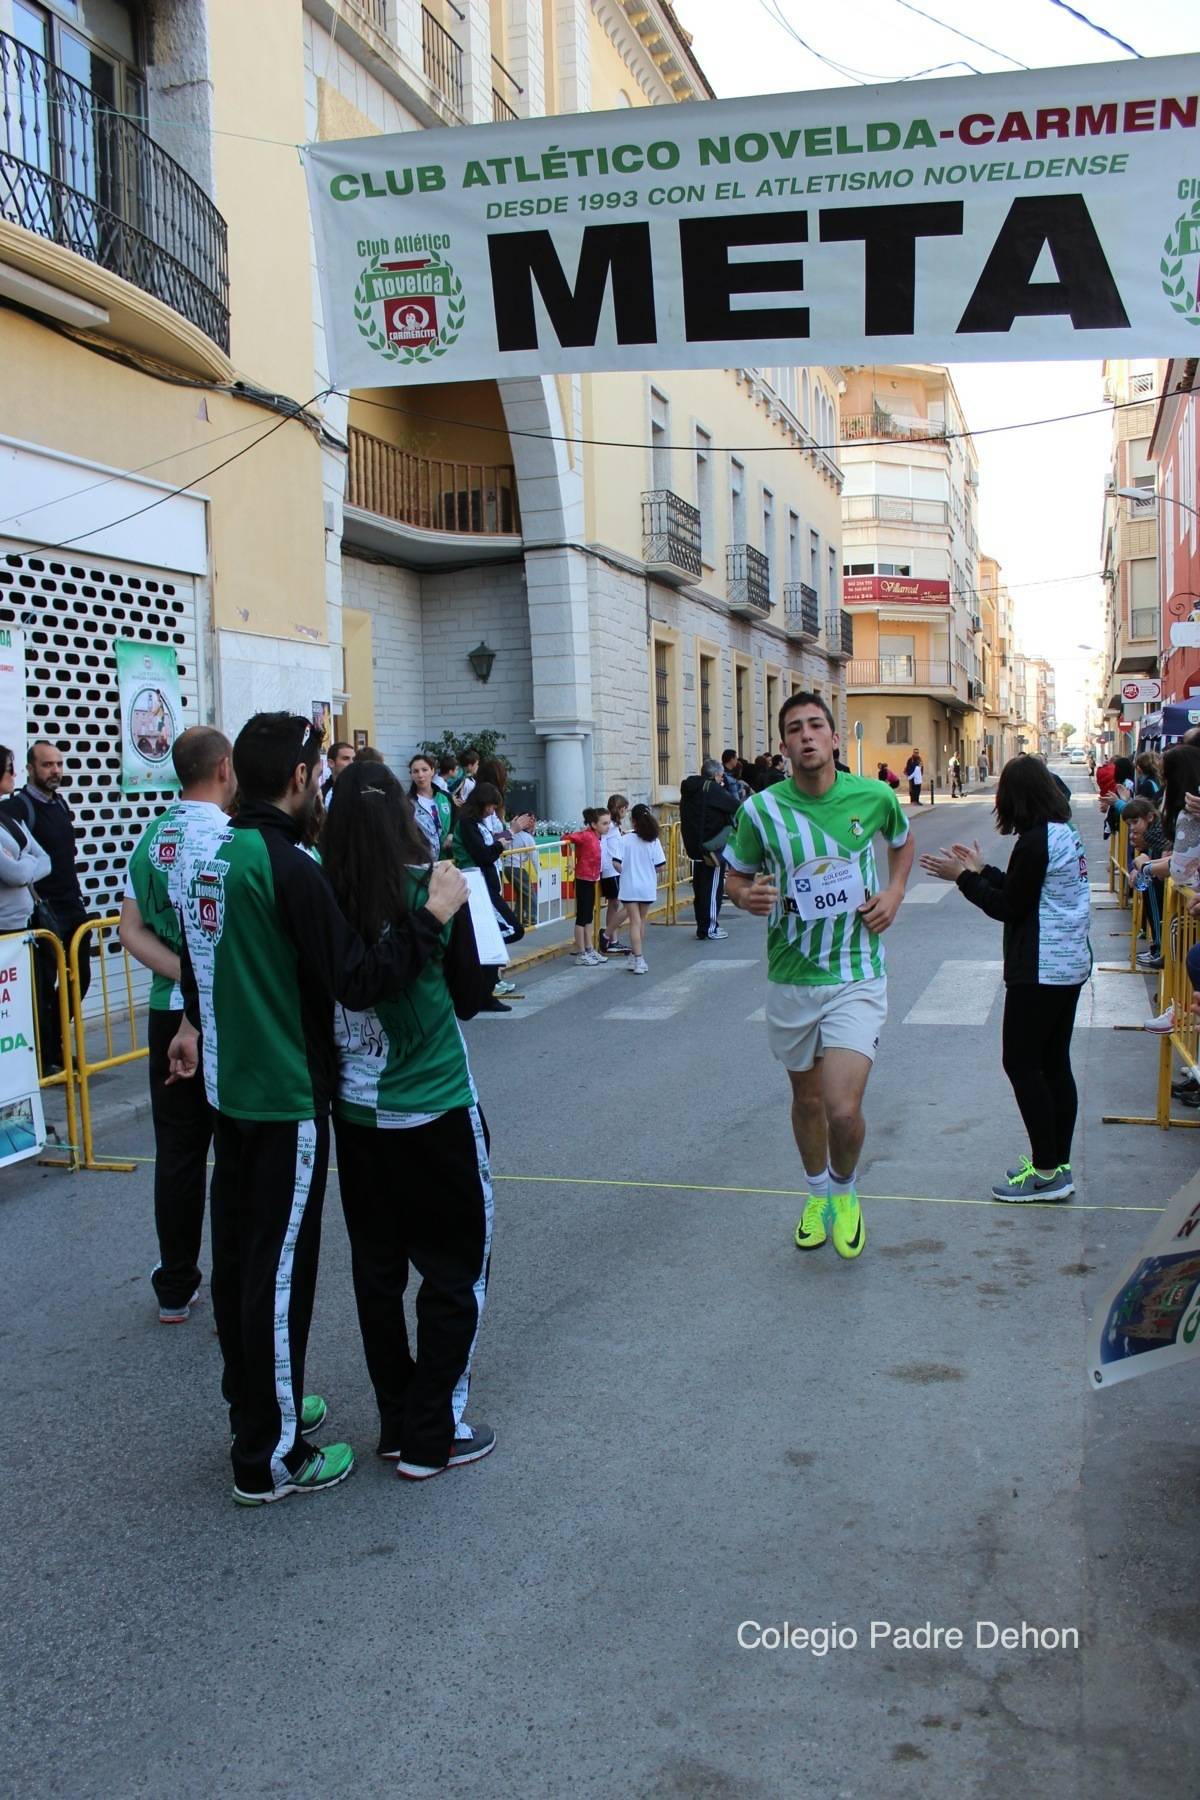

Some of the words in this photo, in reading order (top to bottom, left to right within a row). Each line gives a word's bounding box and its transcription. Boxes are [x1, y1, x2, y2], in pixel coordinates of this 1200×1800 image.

[329, 164, 446, 202] CLUB
[462, 139, 680, 189] ATLÉTICO
[486, 196, 568, 220] DESDE
[578, 189, 638, 212] 1993
[647, 184, 706, 206] CON
[714, 181, 746, 200] EL
[756, 168, 914, 198] ATLETISMO
[923, 153, 1129, 186] NOVELDENSE
[357, 239, 389, 257] Club
[394, 233, 450, 254] Atlético
[372, 273, 444, 298] Novelda
[487, 193, 1132, 352] META
[814, 889, 848, 910] 804
